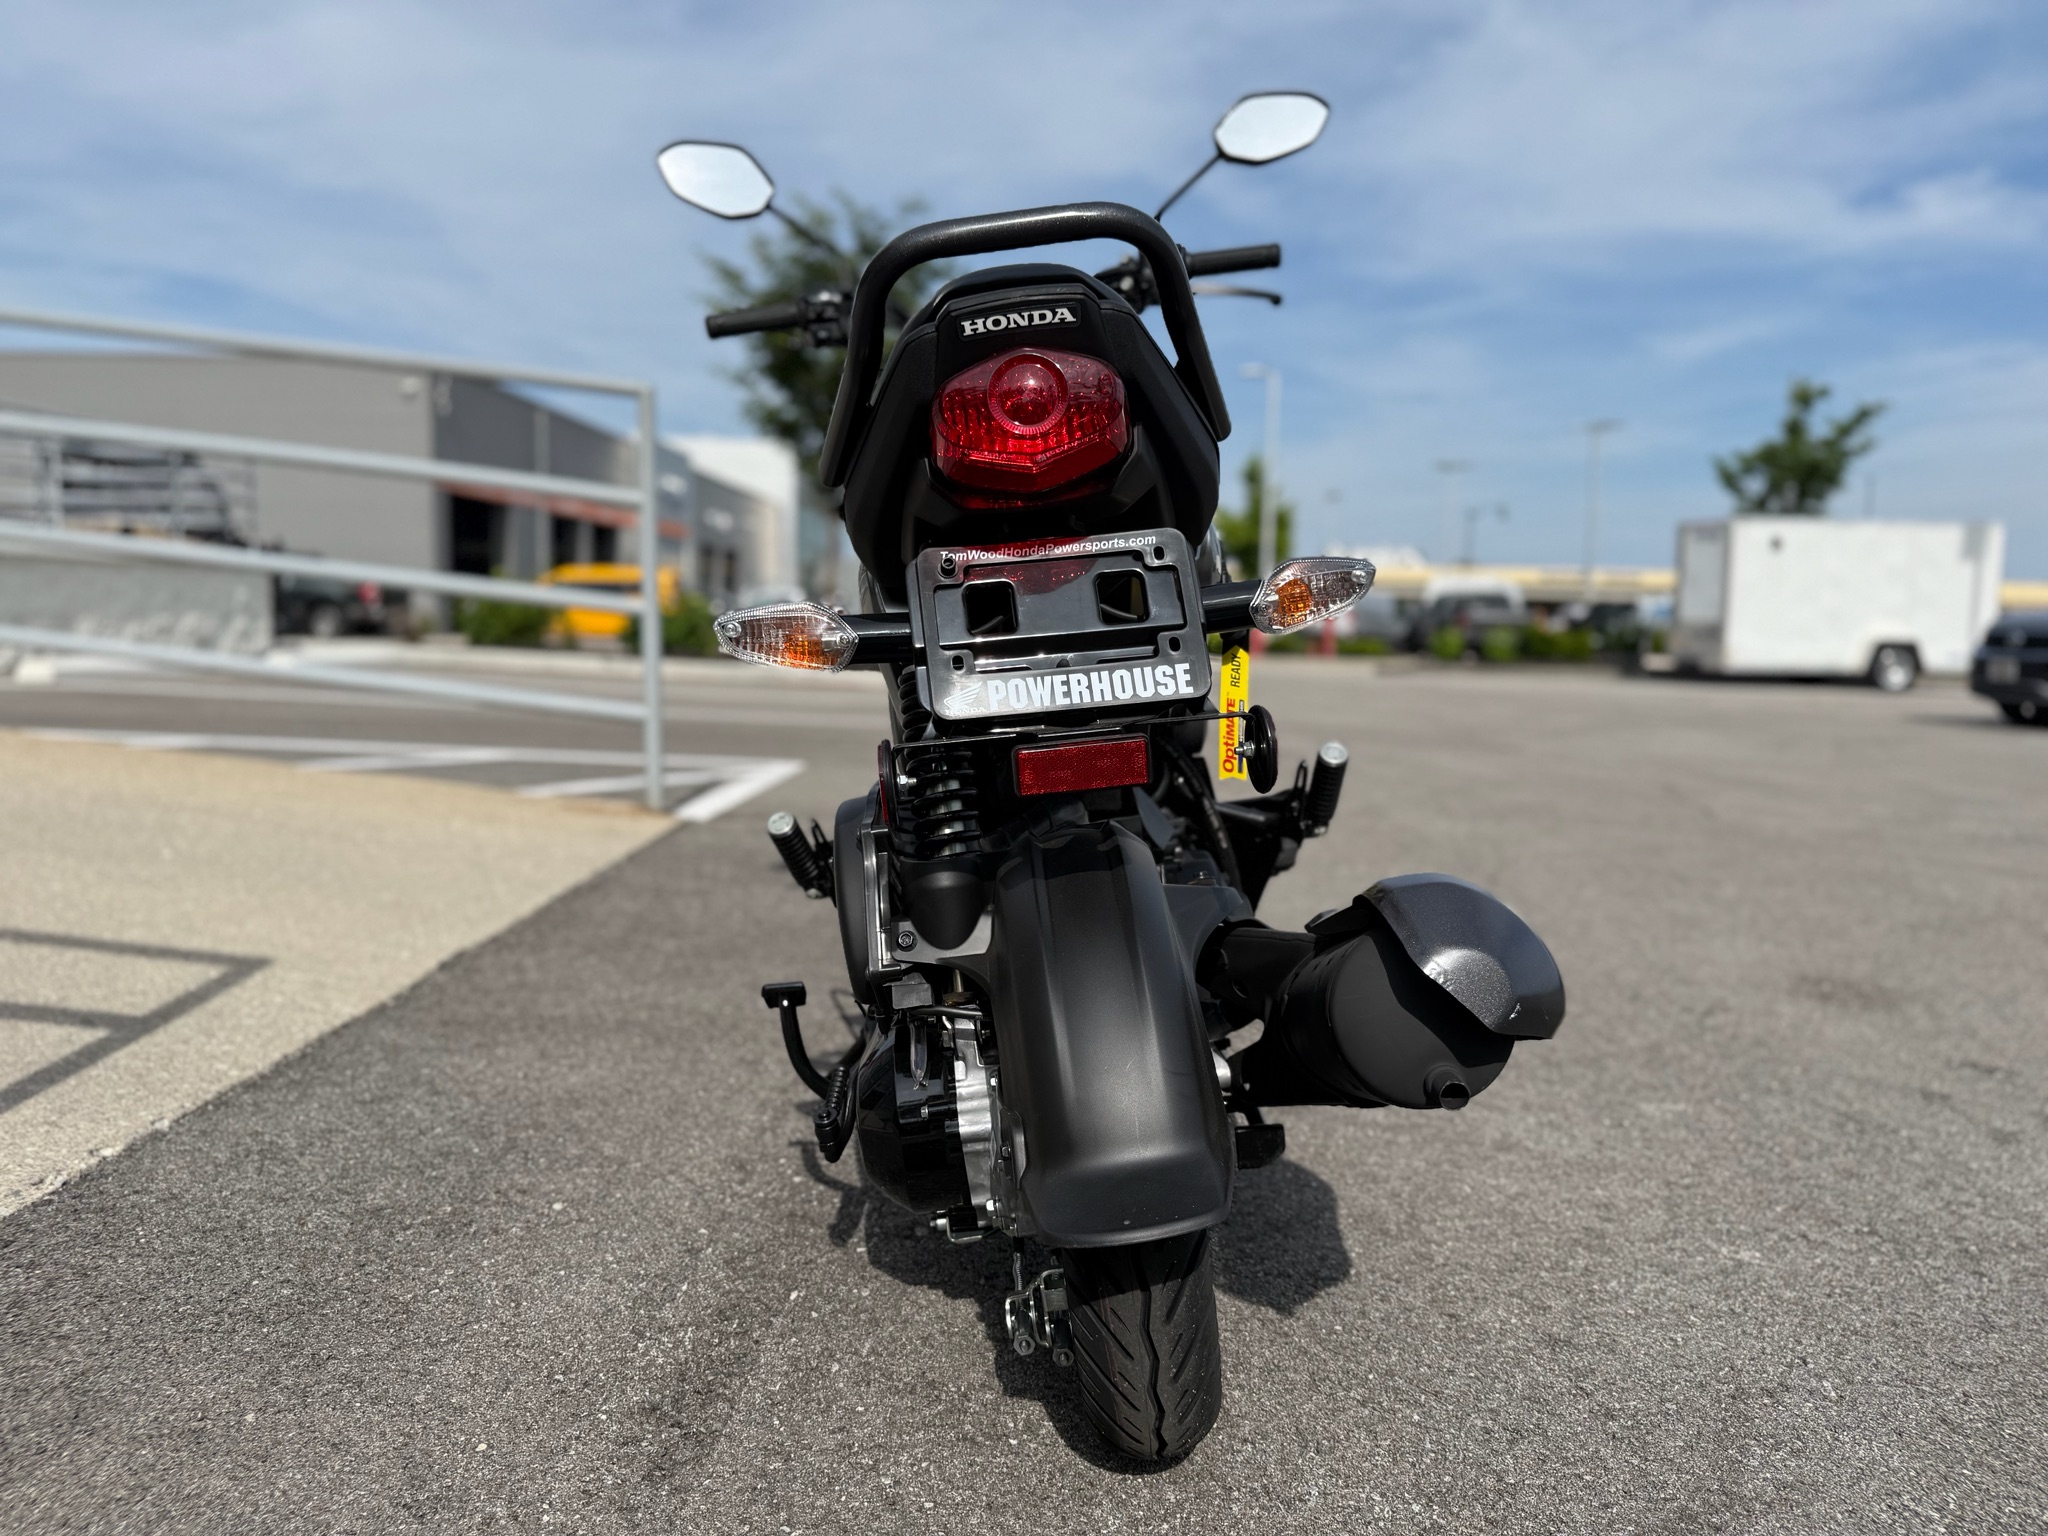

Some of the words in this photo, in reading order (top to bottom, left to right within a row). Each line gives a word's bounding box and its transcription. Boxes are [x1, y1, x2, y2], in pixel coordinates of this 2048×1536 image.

[961, 308, 1077, 336] HONDA
[940, 535, 1156, 562] TomWoodHondaPowersports.com
[1230, 653, 1241, 688] READY
[987, 663, 1194, 711] POWERHOUSE
[945, 707, 986, 717] HONDA
